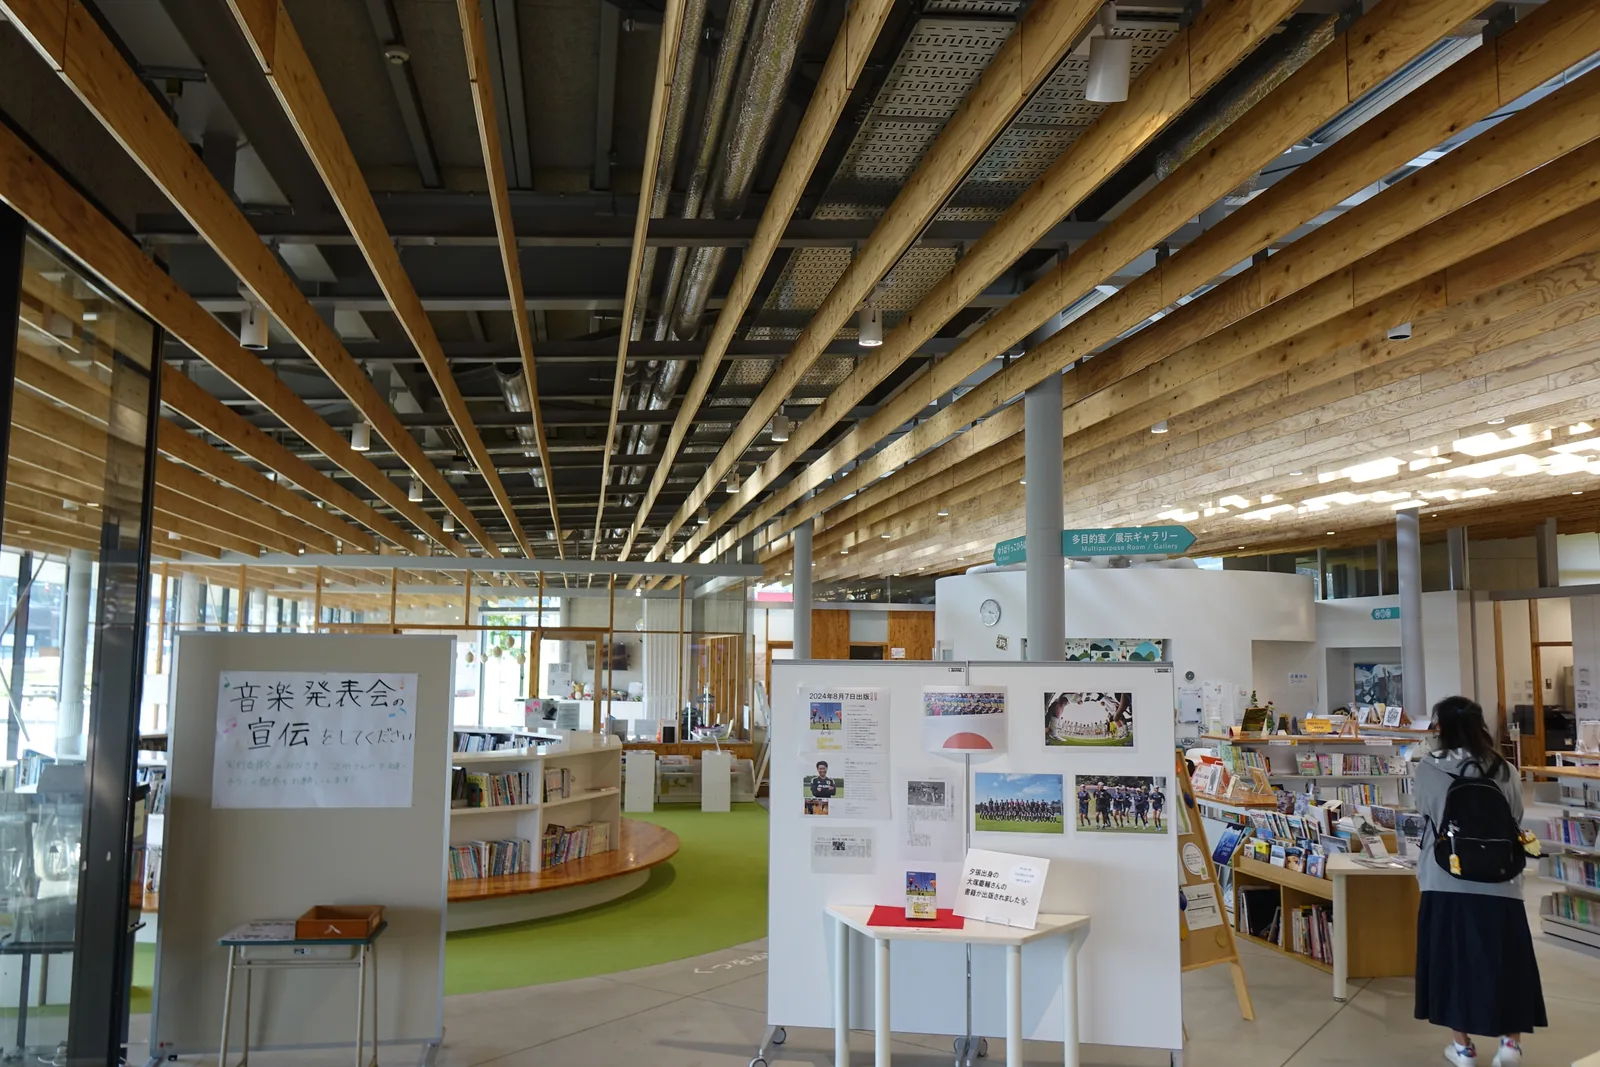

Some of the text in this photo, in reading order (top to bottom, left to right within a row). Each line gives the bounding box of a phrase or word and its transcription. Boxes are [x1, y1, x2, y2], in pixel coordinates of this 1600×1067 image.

[230, 679, 405, 713] 音楽発表会の
[969, 868, 999, 879] 夕張出身の
